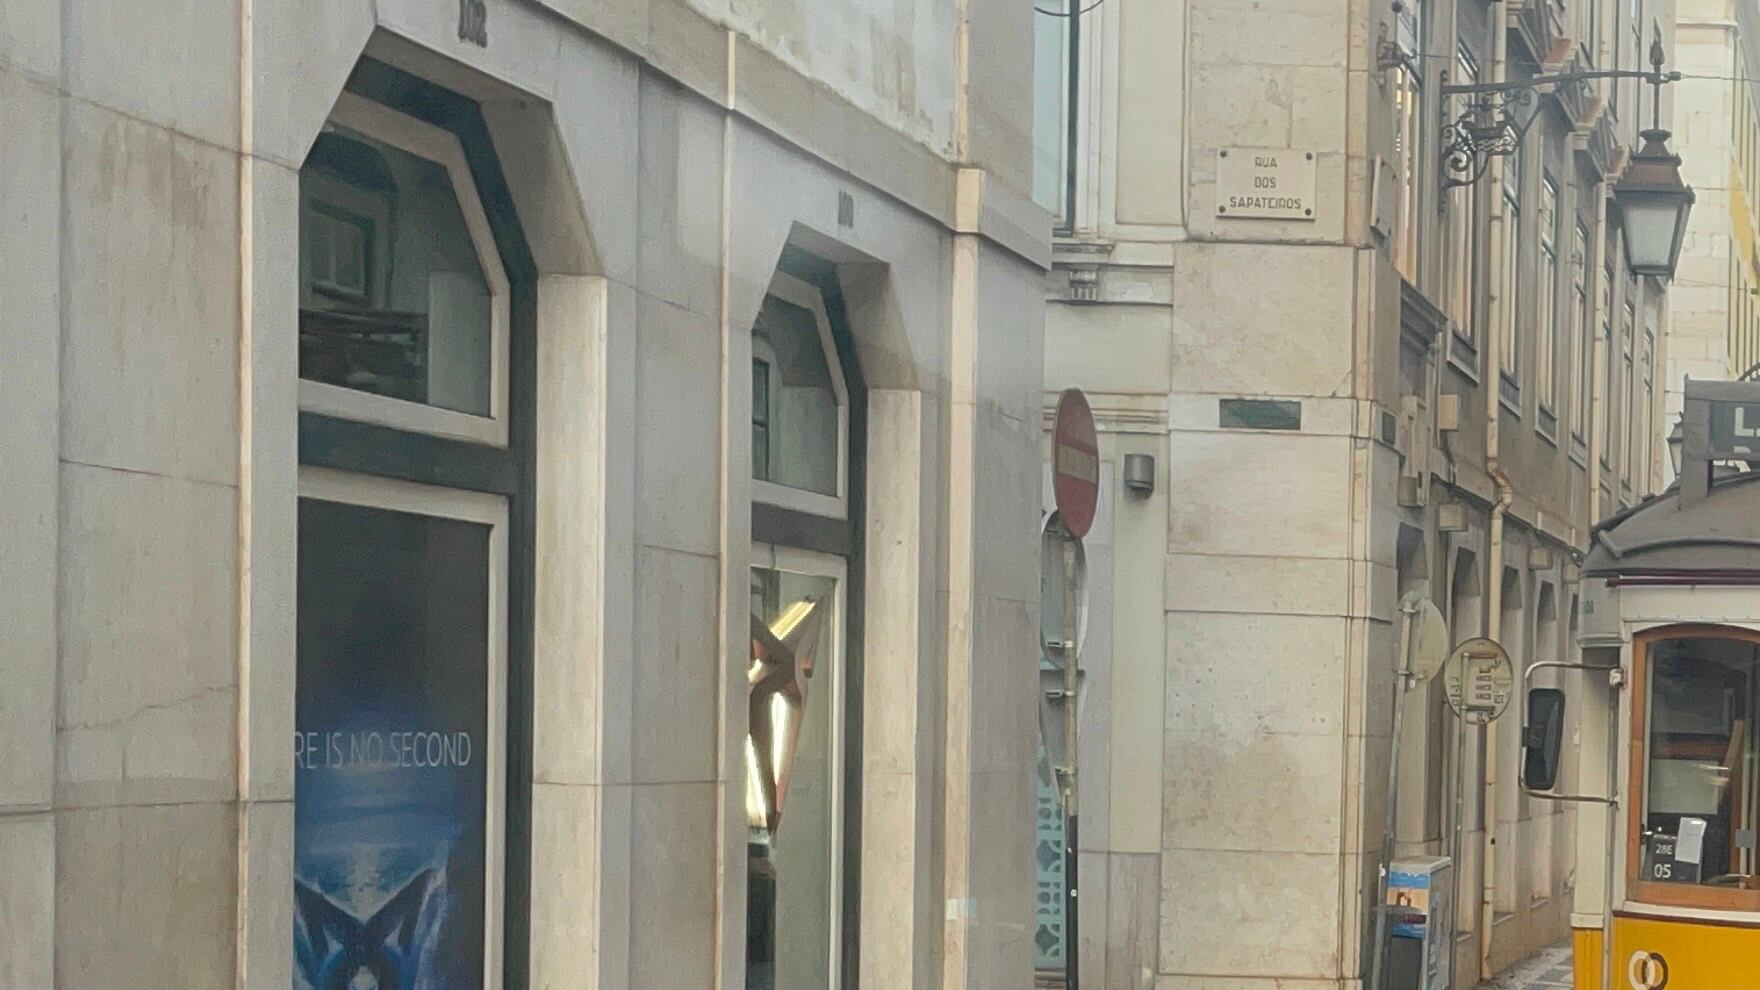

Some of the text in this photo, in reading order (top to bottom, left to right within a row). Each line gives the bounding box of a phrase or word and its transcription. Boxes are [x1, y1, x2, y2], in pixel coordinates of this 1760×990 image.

[1254, 156, 1278, 168] RUA
[1254, 176, 1277, 189] DOS
[1229, 196, 1302, 210] SAPATEIROS
[326, 732, 344, 769] IS
[350, 732, 383, 768] NO
[390, 731, 472, 768] SECOND
[1653, 863, 1671, 879] 05
